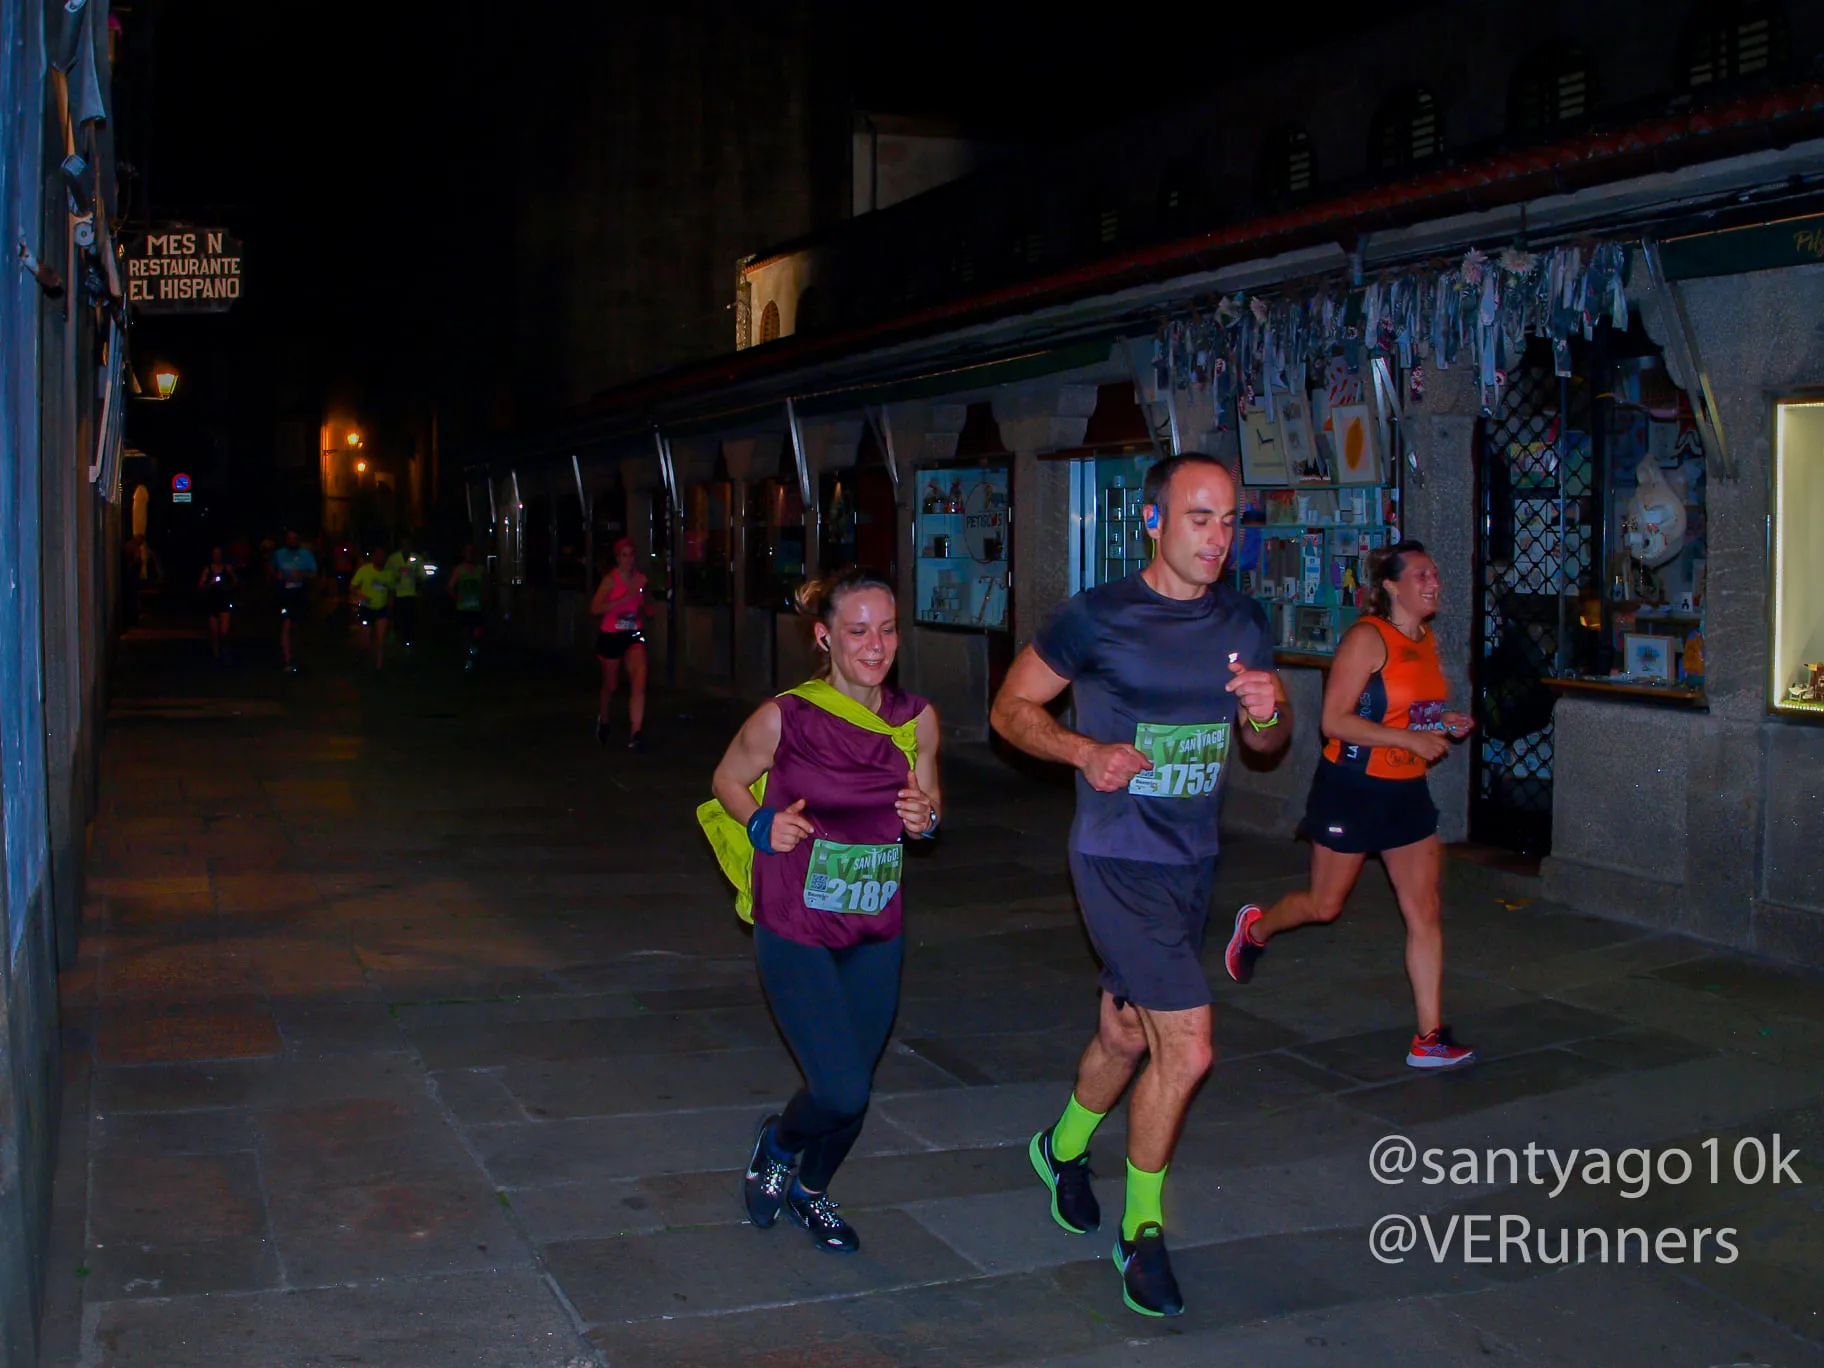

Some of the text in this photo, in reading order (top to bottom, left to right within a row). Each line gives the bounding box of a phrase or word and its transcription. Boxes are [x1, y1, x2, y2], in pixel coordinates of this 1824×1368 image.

[128, 258, 240, 276] RESTAURANTE
[128, 277, 240, 301] EL HISPANO
[1157, 762, 1221, 795] 1753
[828, 878, 899, 912] 2188
